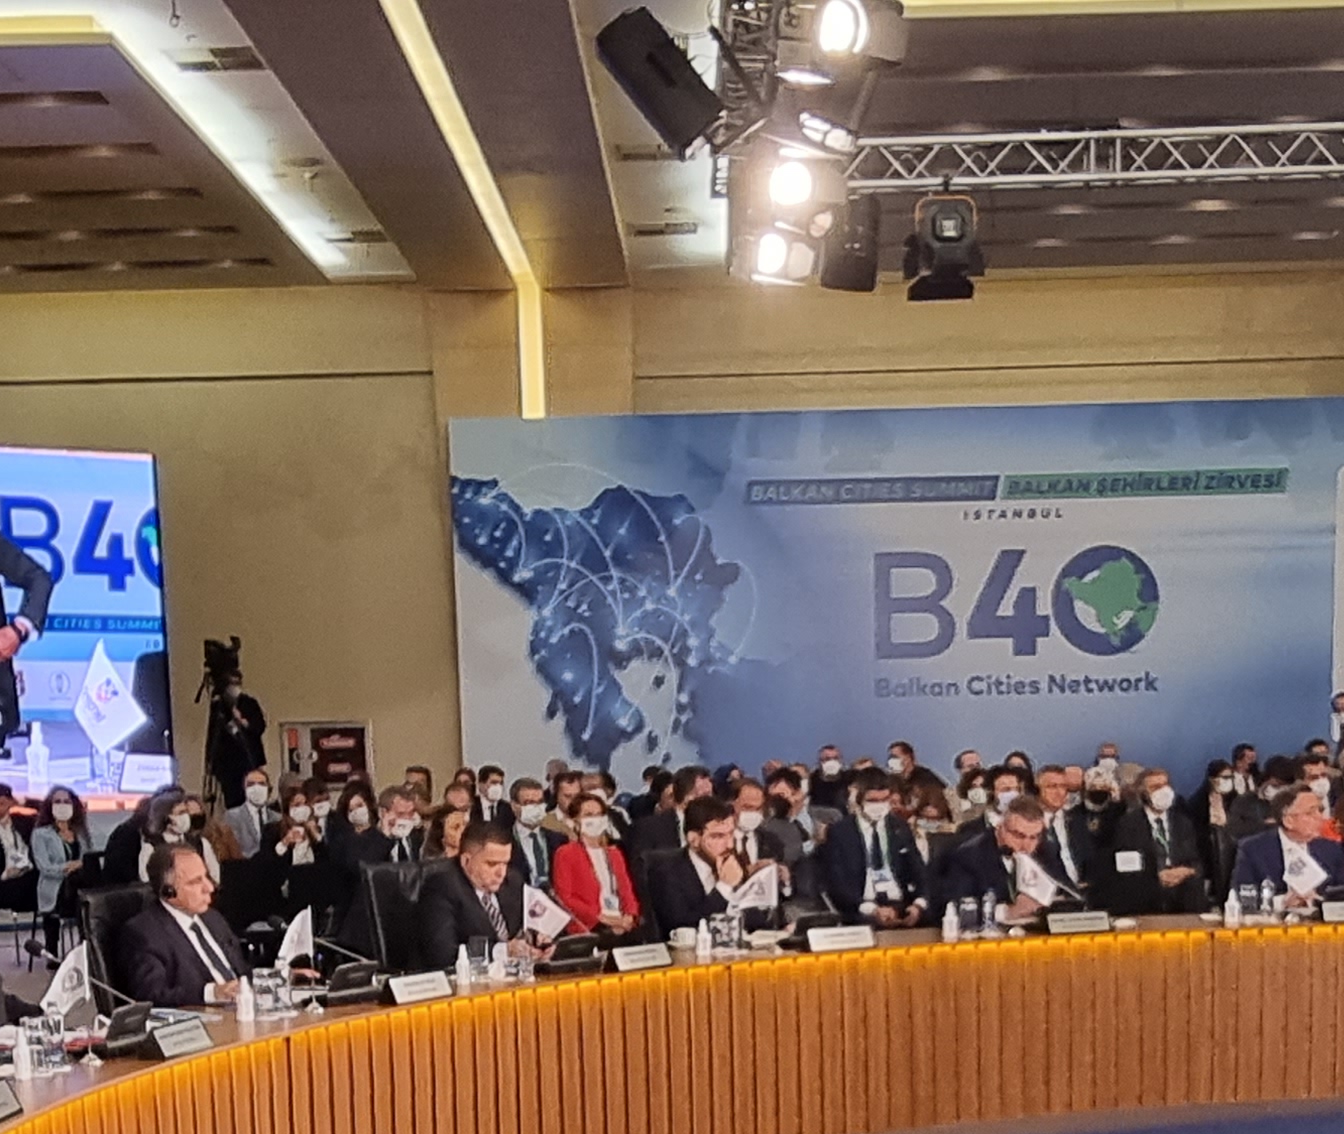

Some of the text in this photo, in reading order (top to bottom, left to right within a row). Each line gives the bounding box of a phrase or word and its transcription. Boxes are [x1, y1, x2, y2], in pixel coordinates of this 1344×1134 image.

[751, 478, 997, 501] BALKAN CITIES SUMMIT
[1008, 478, 1091, 496] BALKAN
[873, 545, 1161, 660] B40
[874, 670, 1159, 699] Balkan Cities Network
